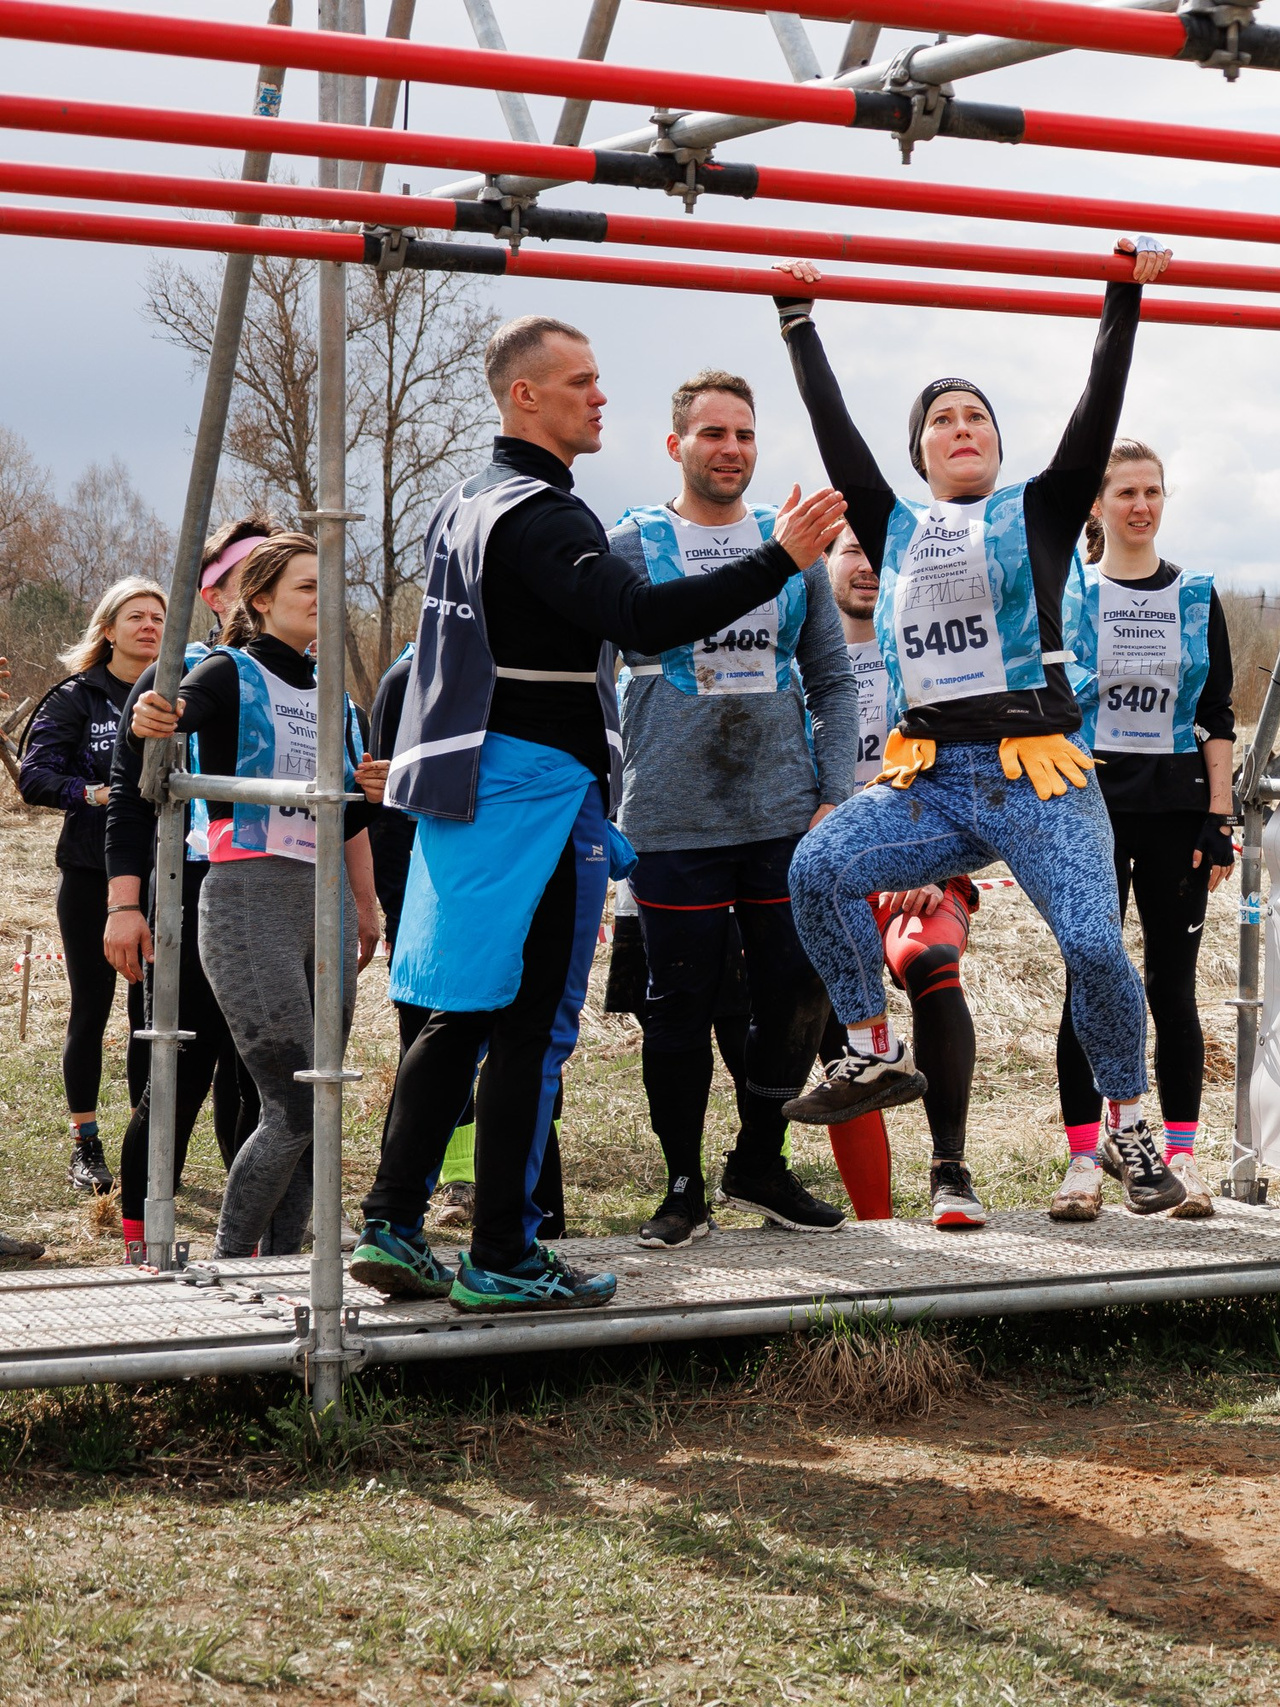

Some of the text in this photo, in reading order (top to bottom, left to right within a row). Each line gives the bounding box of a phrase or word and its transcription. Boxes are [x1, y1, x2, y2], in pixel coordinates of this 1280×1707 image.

[685, 549, 721, 558] ГОНКА
[920, 569, 968, 581] DEVELOPMENT
[1104, 610, 1176, 620] ГОНКА ГЕРОЕВ
[903, 614, 988, 660] 5405
[1113, 625, 1166, 638] Sminex
[726, 671, 765, 679] ГАЗПРОМБАНК
[1108, 659, 1166, 679] ЛЕНА
[935, 671, 985, 685] ГАЗПРОМБАНК
[1107, 684, 1171, 714] 5401
[275, 704, 305, 718] ГОНКА
[1121, 730, 1161, 738] ГАЗПРОМБАНК
